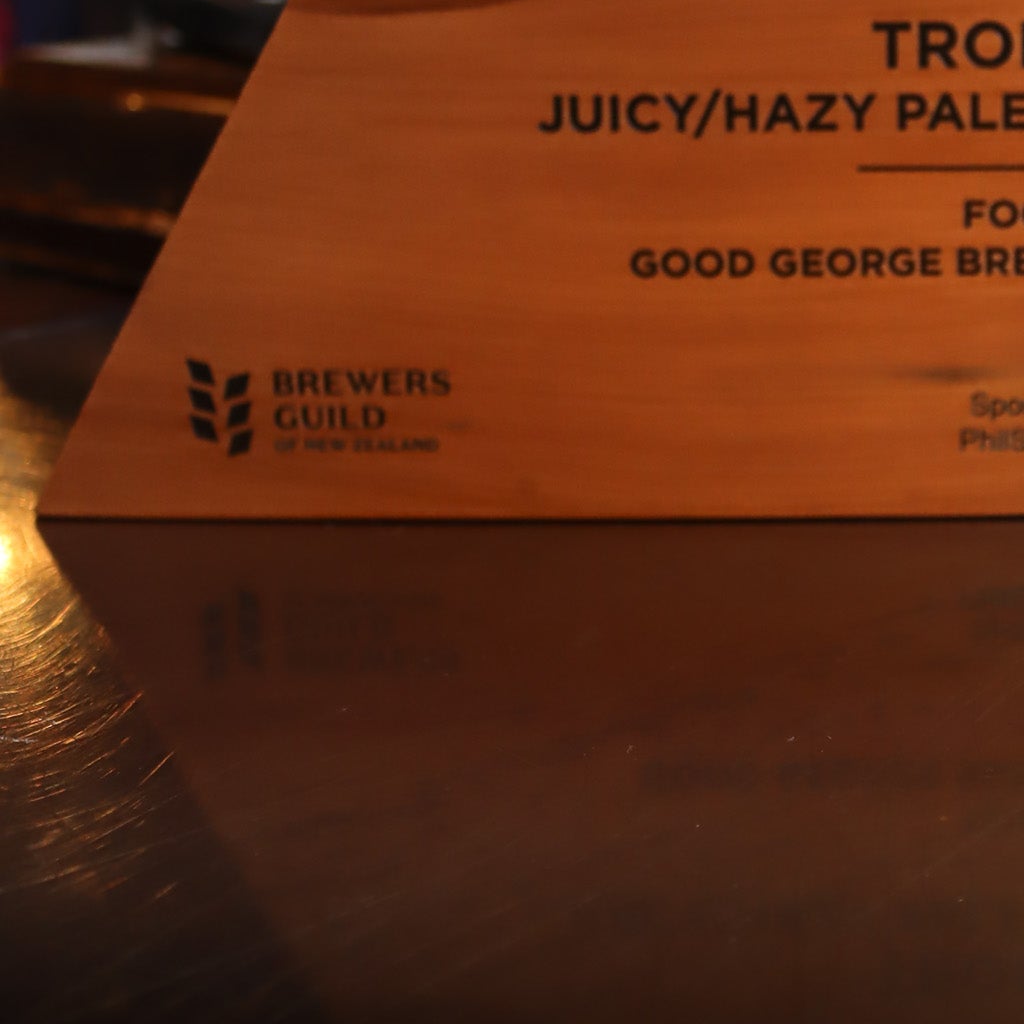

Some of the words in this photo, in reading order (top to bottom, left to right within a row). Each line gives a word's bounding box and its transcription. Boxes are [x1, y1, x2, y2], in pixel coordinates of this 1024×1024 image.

[537, 90, 876, 139] JUICY/HAZY
[630, 249, 756, 280] GOOD
[769, 248, 944, 279] GEORGE
[272, 369, 452, 397] BREWERS
[273, 404, 386, 431] GUILD
